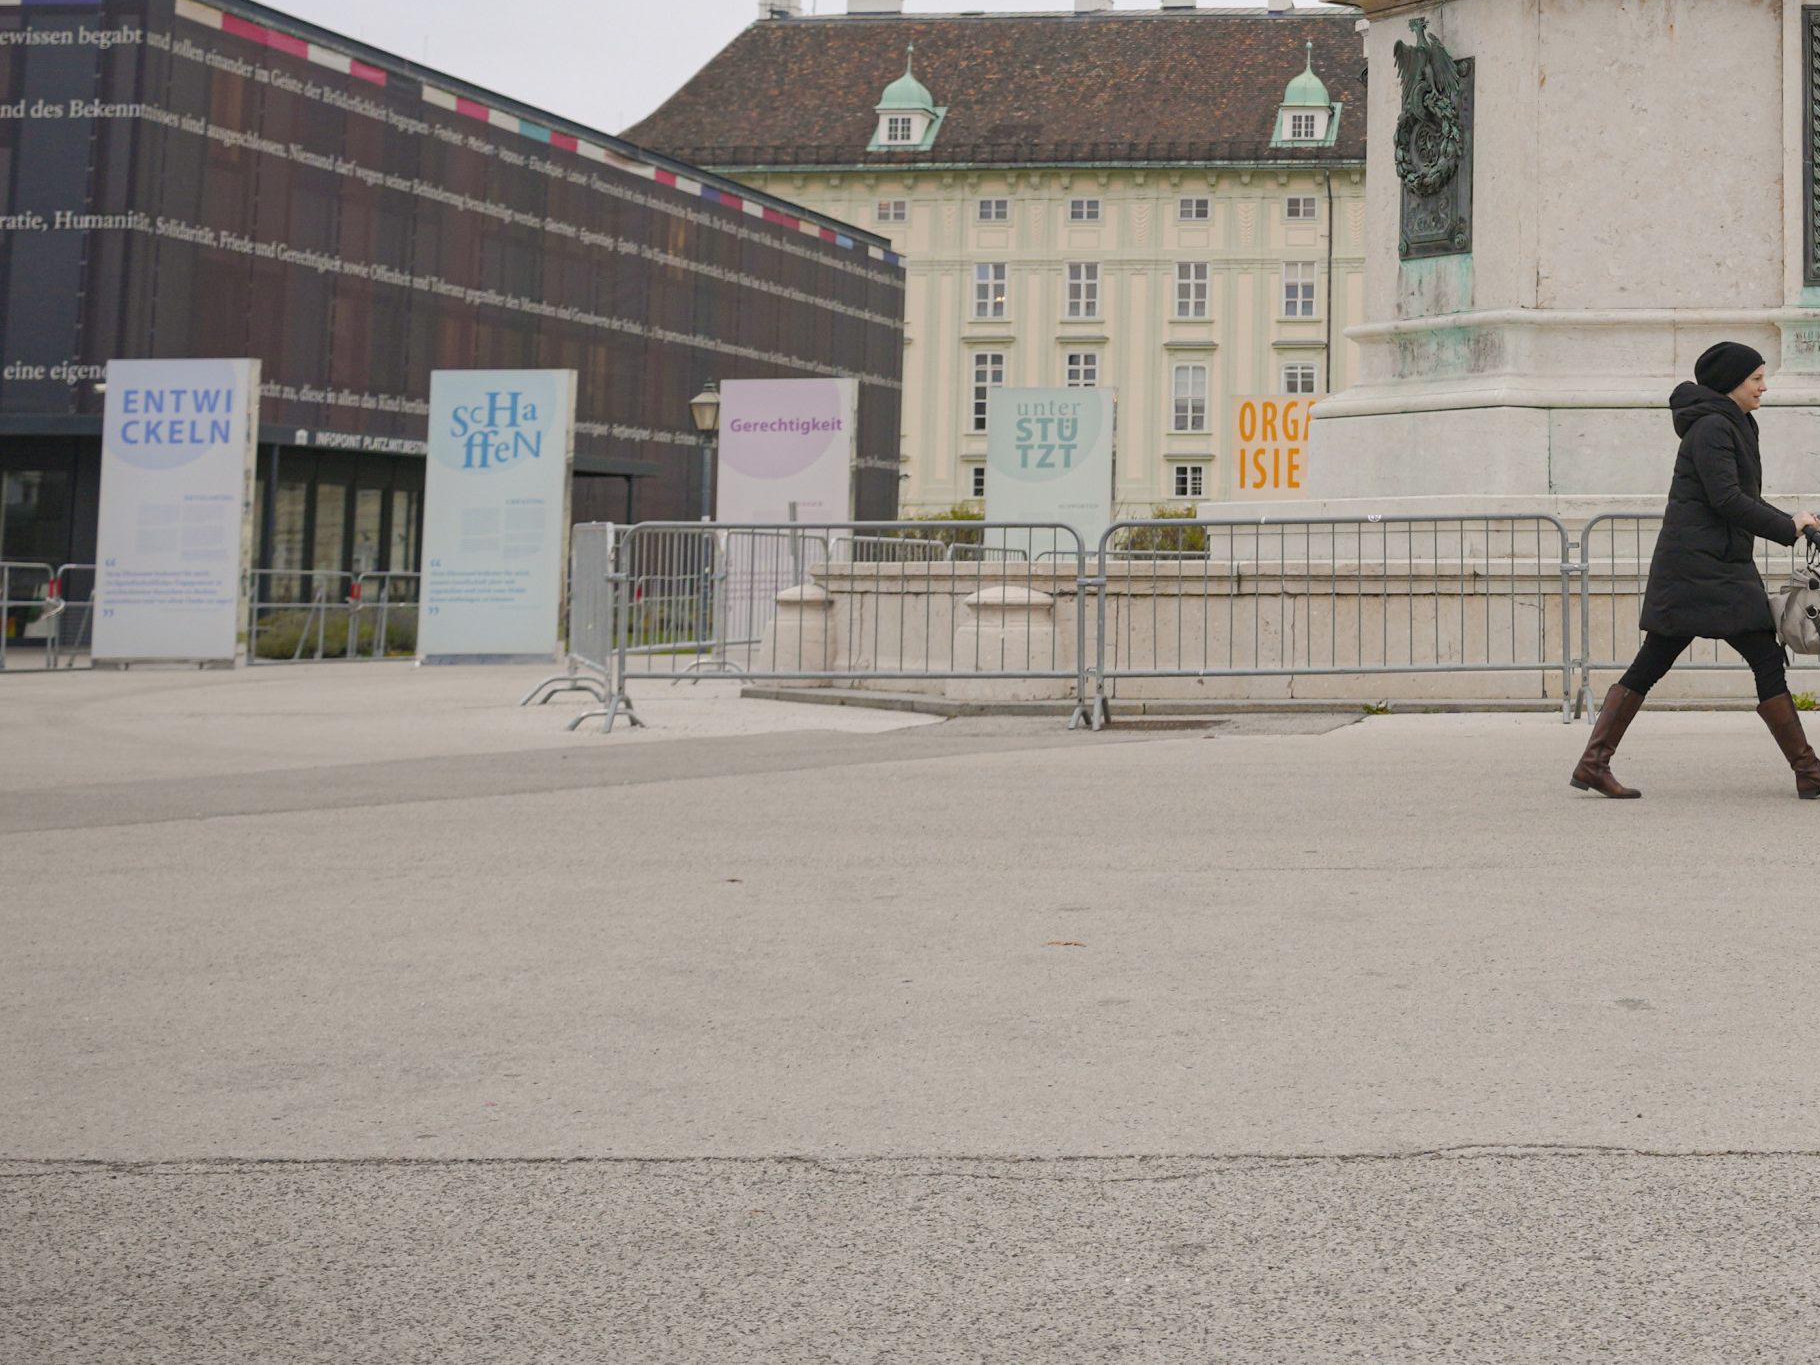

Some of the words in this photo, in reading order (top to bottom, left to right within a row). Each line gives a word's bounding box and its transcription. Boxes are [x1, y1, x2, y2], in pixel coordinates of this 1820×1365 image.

[78, 23, 144, 50] begabt
[146, 32, 171, 50] und
[172, 39, 204, 63] sollen
[205, 49, 253, 77] einander
[30, 99, 64, 119] des
[68, 98, 179, 128] Bekenntnisses
[180, 112, 206, 136] sind
[54, 210, 153, 234] Humanität,
[155, 215, 217, 247] Solidarität,
[219, 228, 253, 254] Friede
[254, 240, 276, 258] und
[276, 241, 342, 273] Gerechtigkeit
[3, 359, 45, 379] eine
[122, 389, 232, 414] ENTWI
[299, 383, 325, 403] diese
[378, 393, 400, 411] Kind
[1017, 399, 1081, 416] unter
[120, 419, 230, 445] CKELN
[730, 417, 842, 435] Gerechtigkeit
[1015, 417, 1078, 443] STÜ
[315, 430, 361, 450] INFOPOINT
[1015, 443, 1078, 469] TZT
[1239, 447, 1301, 490] ISIE
